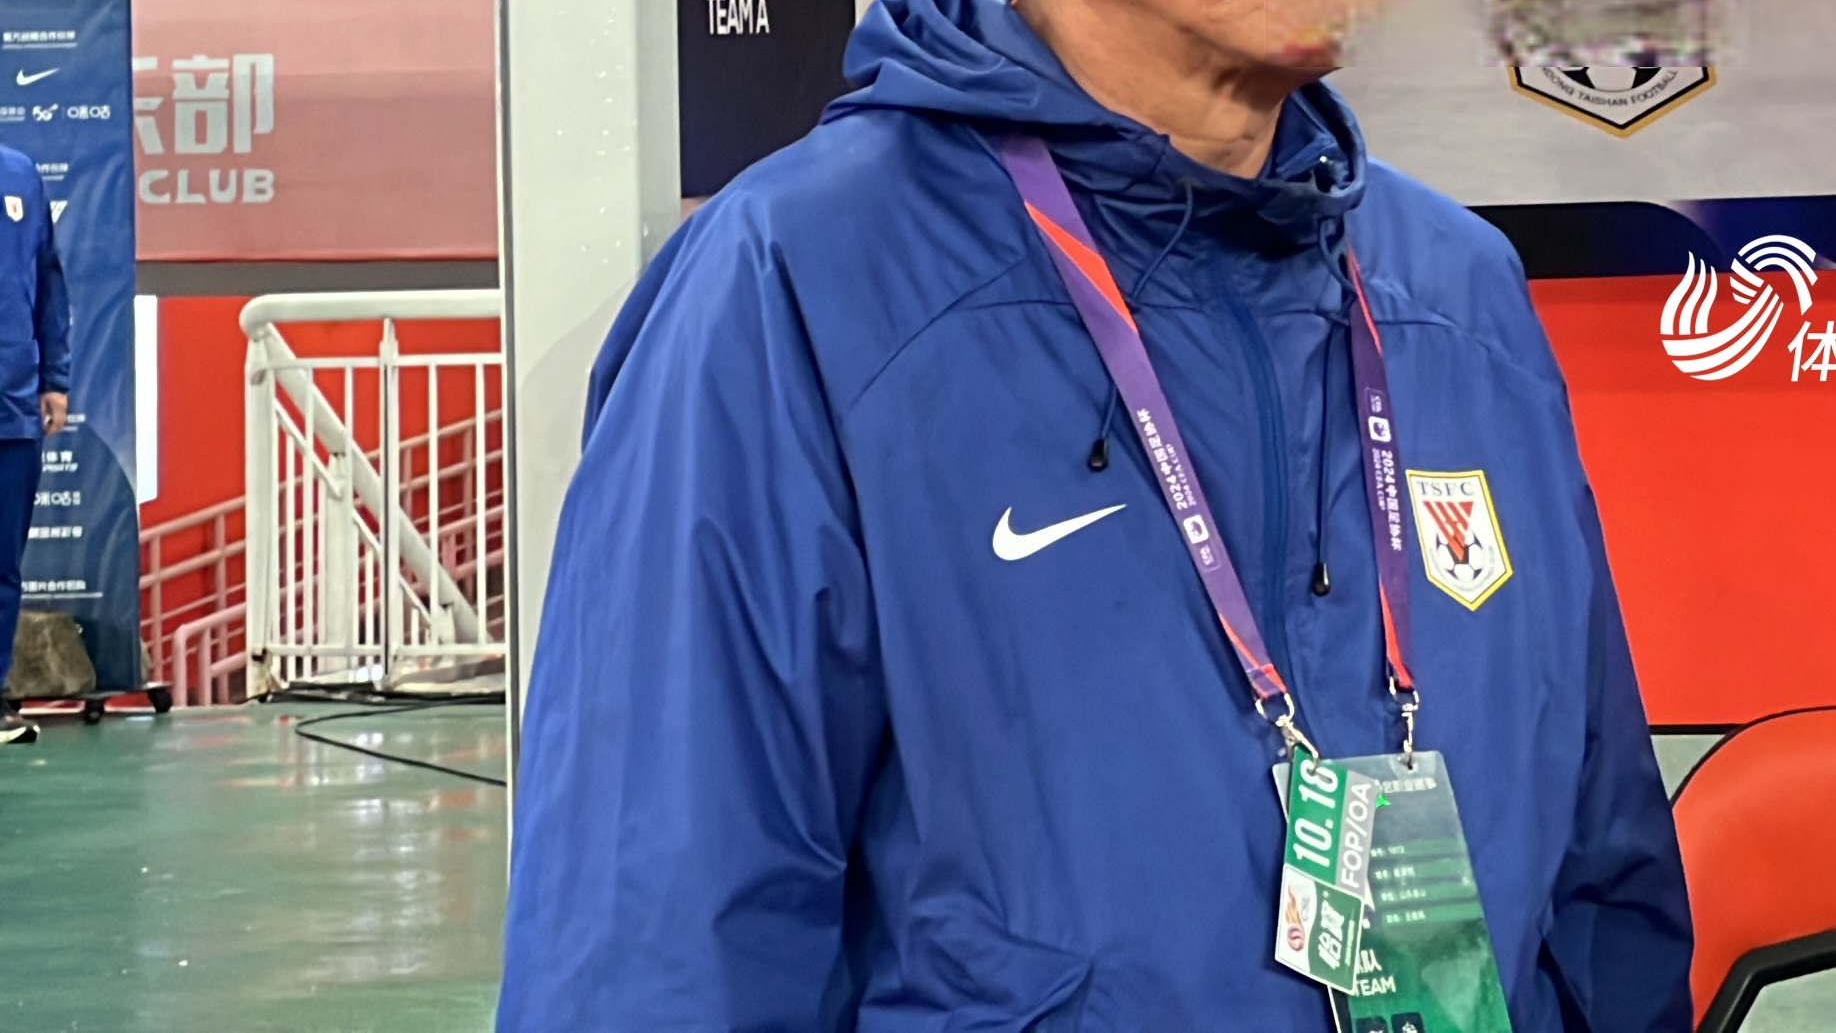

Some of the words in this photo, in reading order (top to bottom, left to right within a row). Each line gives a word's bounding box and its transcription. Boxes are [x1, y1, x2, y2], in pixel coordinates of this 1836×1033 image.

[1576, 90, 1629, 106] TAISHAN
[1630, 68, 1679, 105] FOOTBALL
[138, 168, 275, 204] CLUB
[1416, 481, 1476, 497] TSFC
[1293, 759, 1339, 868] 10.18
[1342, 782, 1372, 889] FOP/OA
